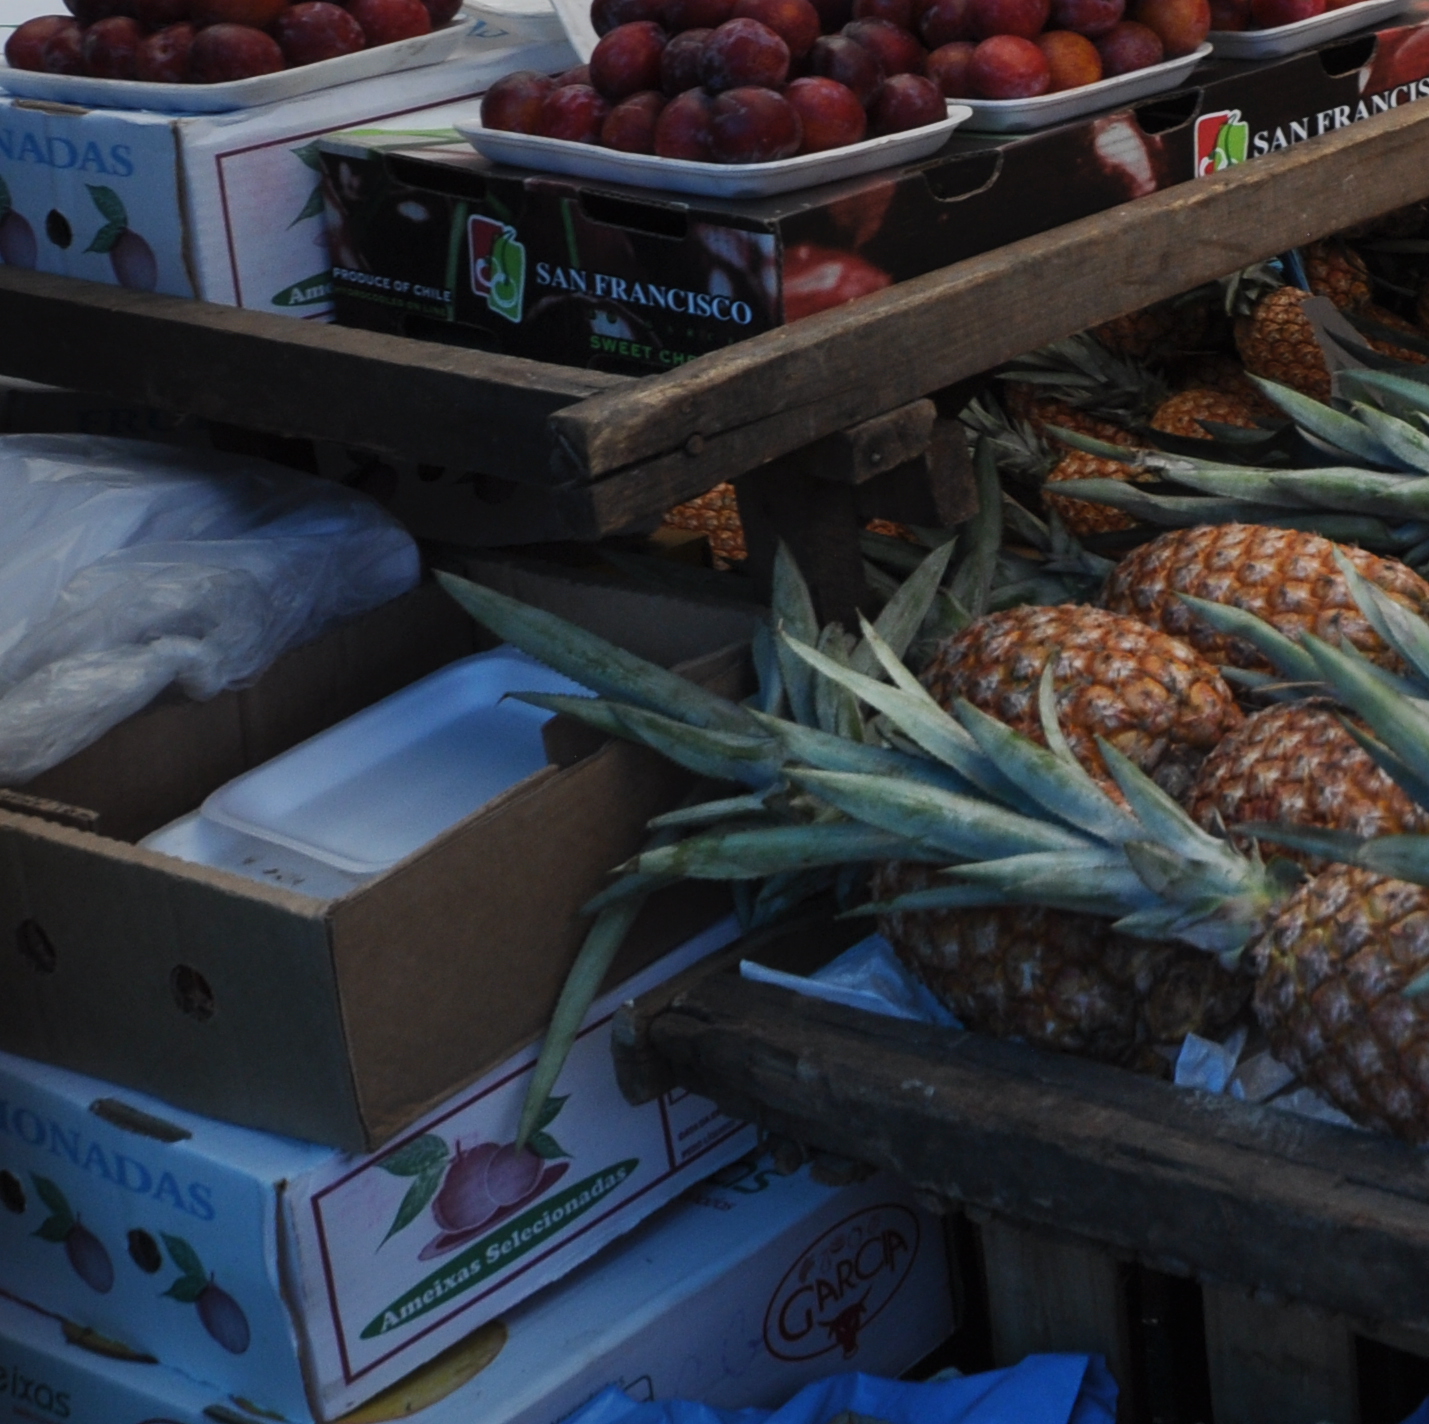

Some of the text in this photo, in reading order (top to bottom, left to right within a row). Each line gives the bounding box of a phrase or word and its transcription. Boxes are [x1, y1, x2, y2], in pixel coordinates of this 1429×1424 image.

[1253, 117, 1309, 158] SAN
[333, 266, 451, 302] PRODUCE OF CHILE
[535, 262, 753, 325] SAN FRANCISCO
[589, 335, 651, 360] SWEET
[381, 1258, 483, 1331] Ameixas
[486, 1166, 628, 1267] Selecionadas
[779, 1229, 908, 1342] GARCIA
